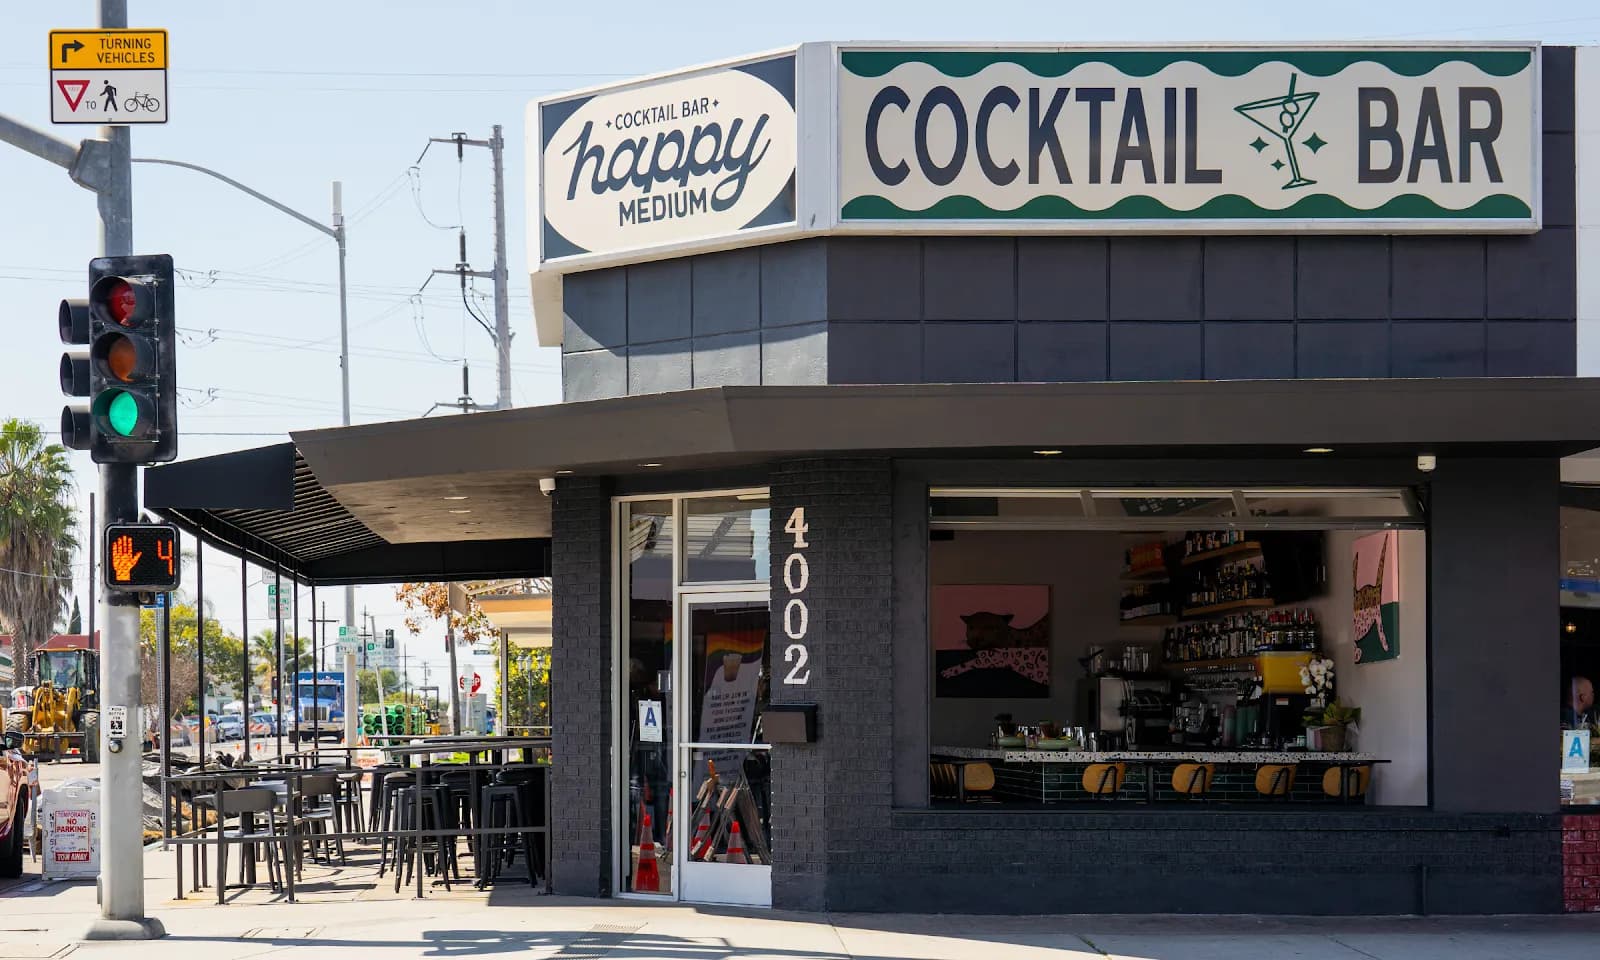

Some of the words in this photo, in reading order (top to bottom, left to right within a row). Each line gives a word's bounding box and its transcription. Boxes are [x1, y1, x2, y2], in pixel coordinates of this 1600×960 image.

[99, 38, 151, 49] TURNING
[97, 52, 155, 63] VEHICLES
[85, 101, 96, 110] TO
[615, 103, 678, 130] COCKTAIL
[682, 97, 709, 117] BAR
[865, 86, 1223, 187] COCKTAIL
[1357, 86, 1504, 184] BAR
[562, 113, 771, 212] happy
[619, 187, 707, 227] MEDIUM
[157, 538, 173, 576] 4
[783, 507, 810, 685] 4002
[460, 677, 480, 688] SP
[644, 706, 657, 726] A
[1568, 736, 1583, 757] A
[56, 825, 87, 833] PARKING
[70, 853, 87, 861] AWAY
